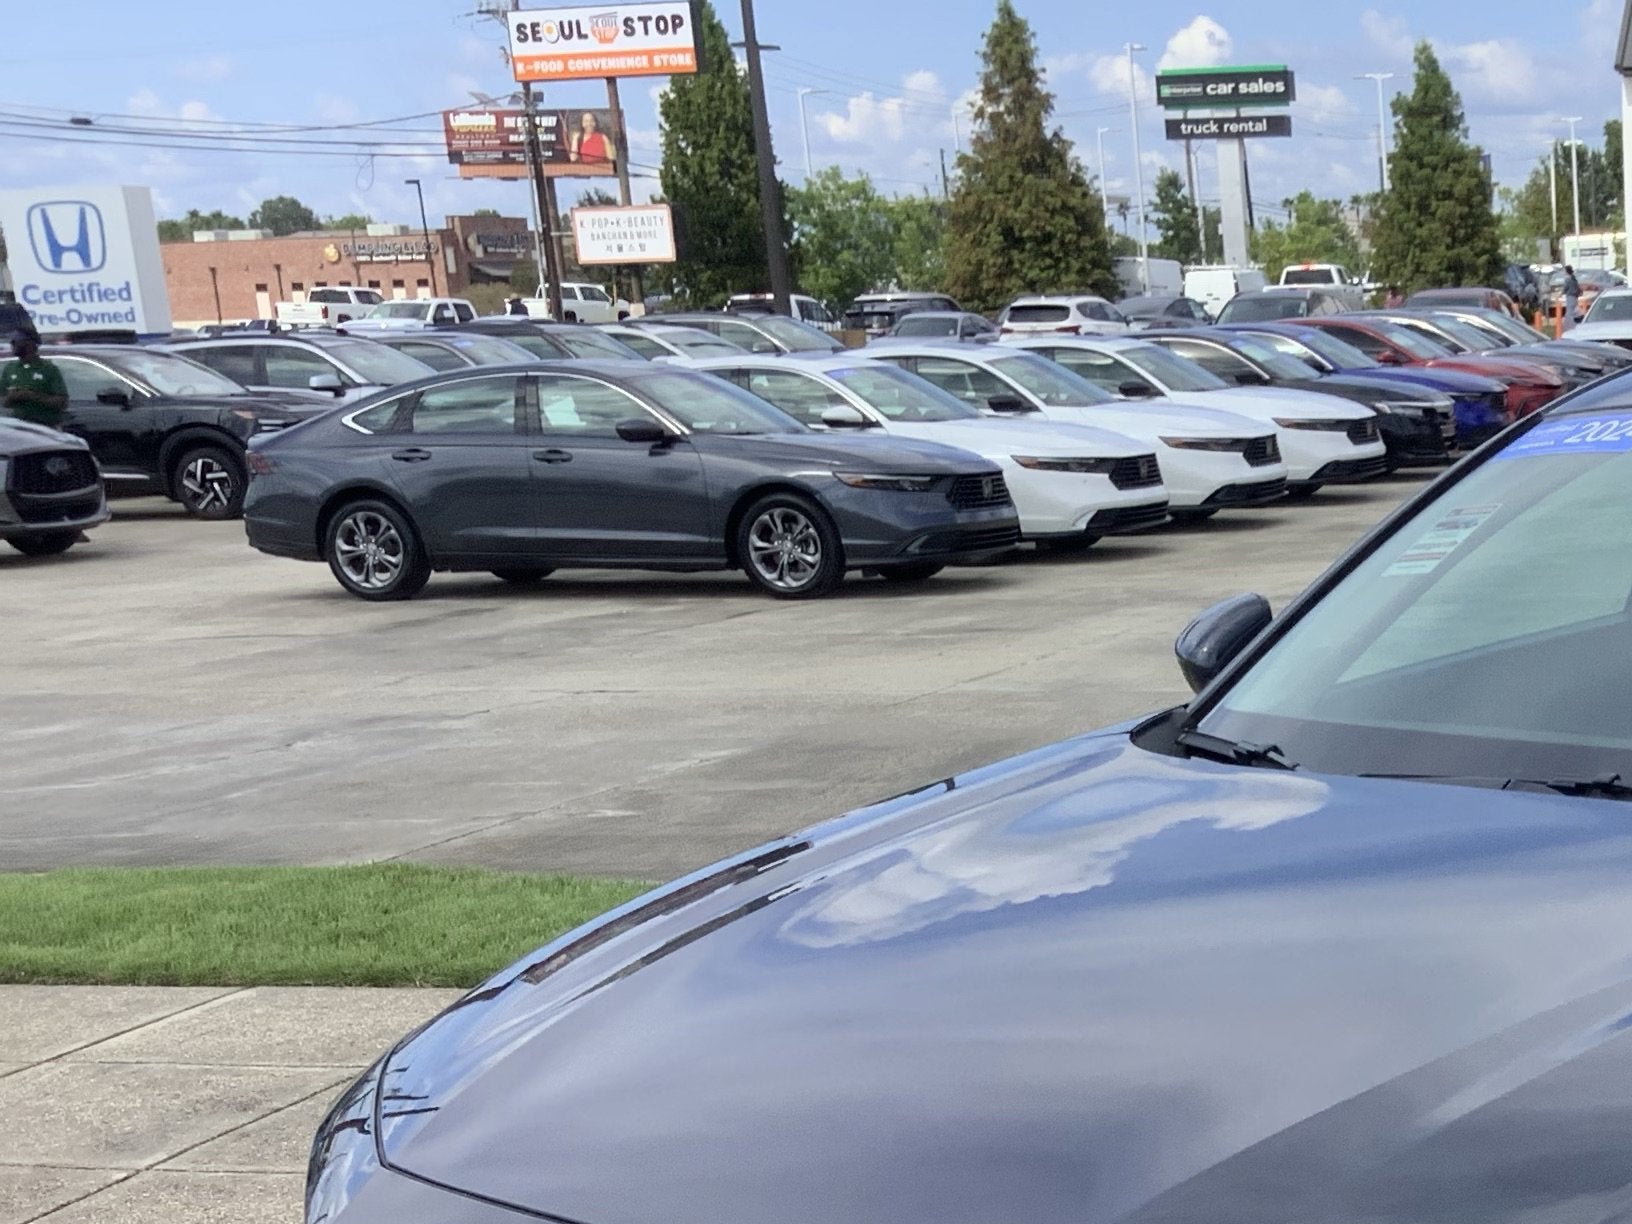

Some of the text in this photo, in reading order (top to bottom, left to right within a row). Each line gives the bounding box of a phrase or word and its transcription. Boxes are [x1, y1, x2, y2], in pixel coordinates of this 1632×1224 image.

[622, 14, 684, 37] STOP
[516, 52, 693, 74] K-FOOD CONVENIENCE STORE
[1206, 83, 1235, 96] car
[1238, 78, 1286, 94] sales
[1180, 118, 1268, 134] truck rental
[21, 280, 132, 305] Certified
[28, 307, 136, 326] Pre-Owned
